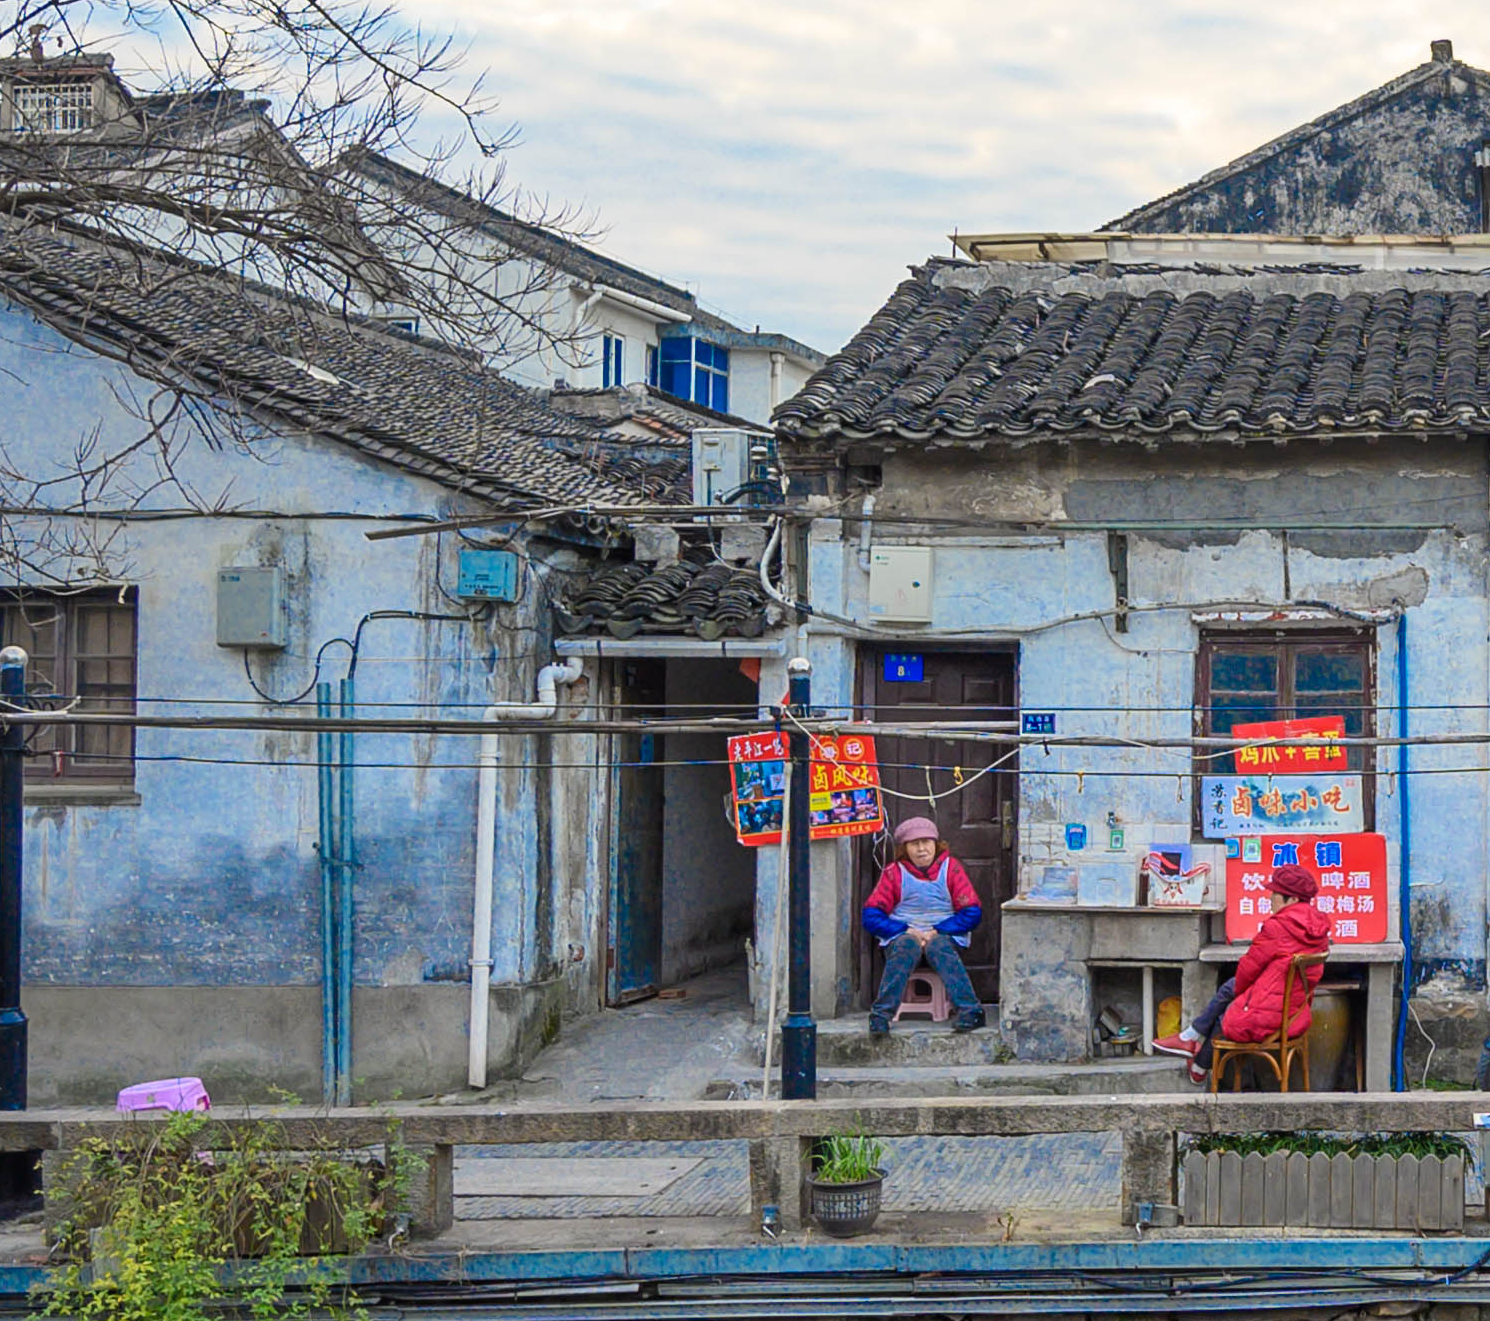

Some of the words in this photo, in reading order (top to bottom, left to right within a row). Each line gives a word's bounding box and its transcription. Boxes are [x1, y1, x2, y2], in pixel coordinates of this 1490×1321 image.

[897, 665, 905, 677] 8
[1232, 785, 1351, 818] 卤味小吃
[1272, 841, 1343, 868] 冰镇
[1321, 871, 1371, 890] 啤酒
